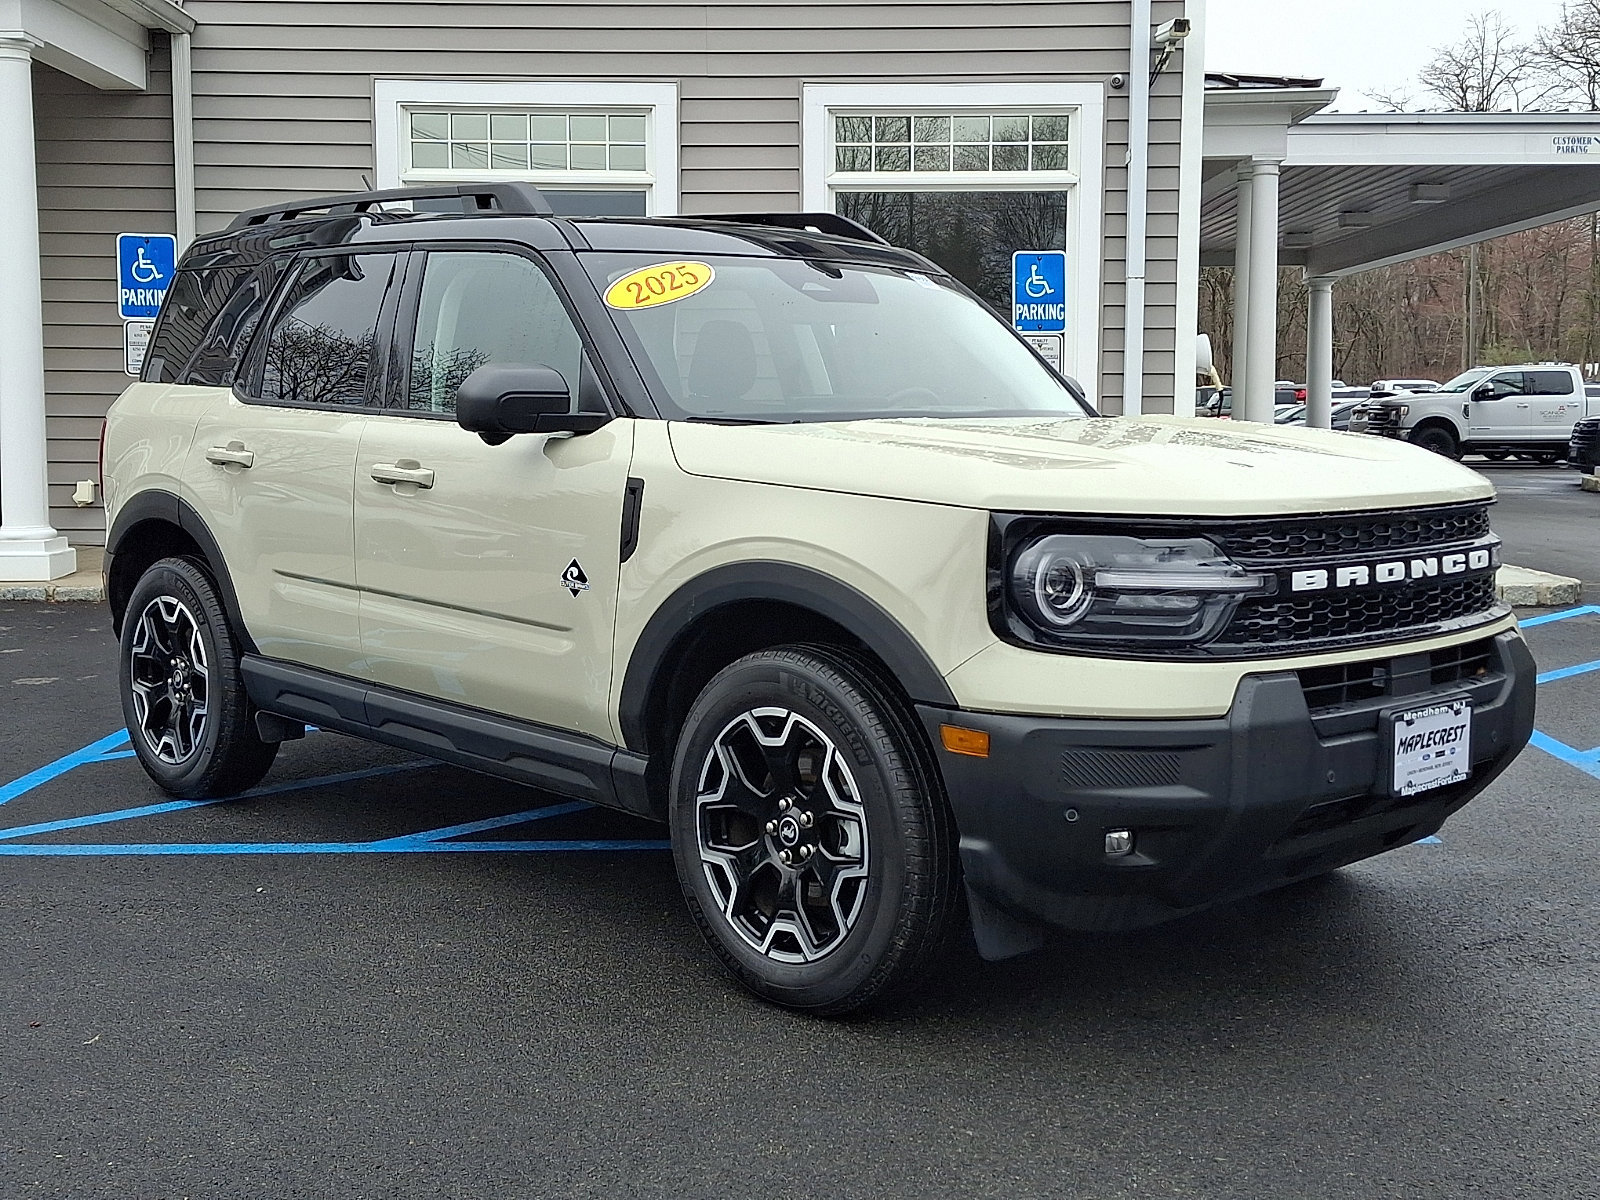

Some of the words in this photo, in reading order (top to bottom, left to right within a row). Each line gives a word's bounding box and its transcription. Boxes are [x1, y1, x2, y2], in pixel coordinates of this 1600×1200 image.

[1552, 136, 1592, 145] CUSTOMER
[1556, 145, 1588, 154] PARKING
[626, 265, 699, 304] 2025
[122, 288, 167, 306] PARKIN
[1015, 303, 1065, 320] PARKING
[1291, 549, 1489, 592] BRONCO
[1453, 700, 1466, 711] NJ
[809, 688, 869, 765] MICHELIN
[1397, 724, 1467, 756] MAPLECREST
[1401, 773, 1468, 797] MaplecrestFord.com
